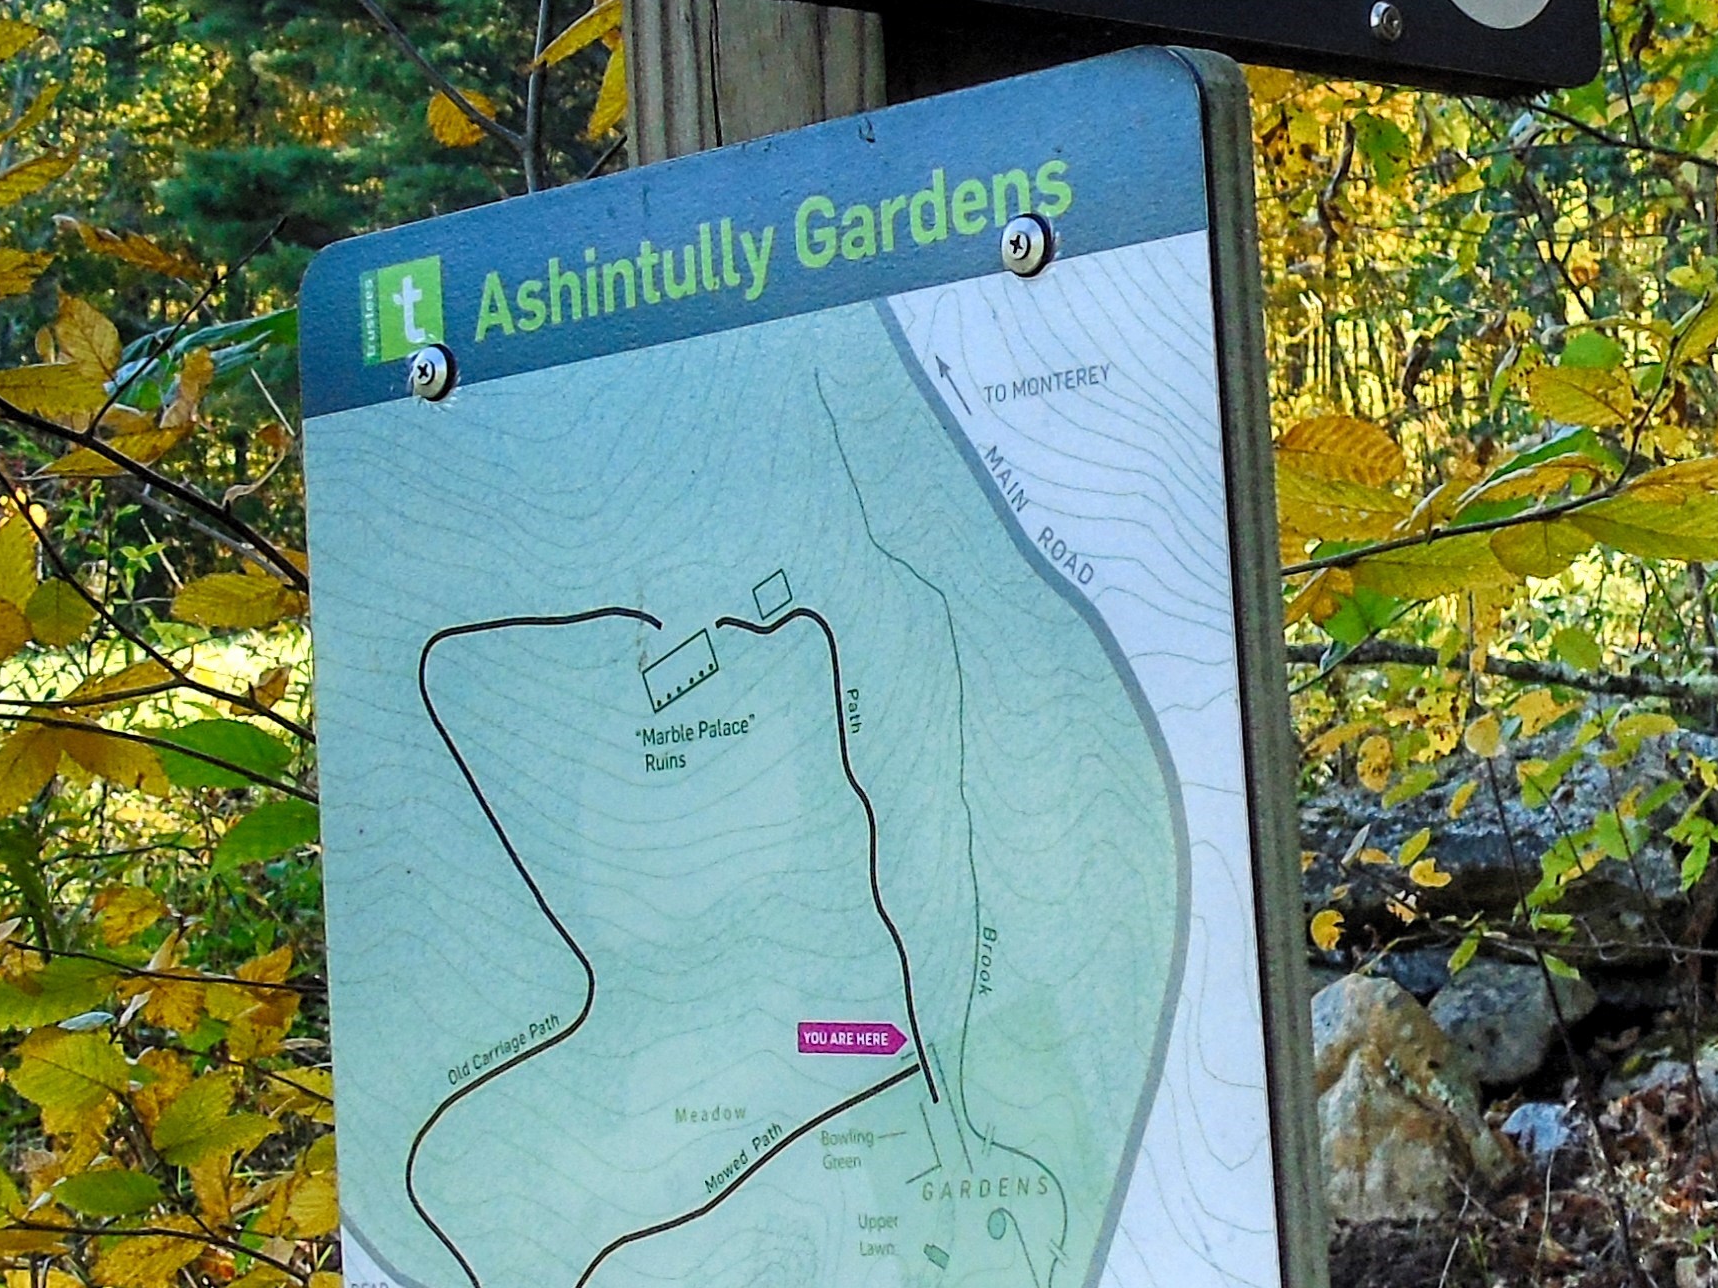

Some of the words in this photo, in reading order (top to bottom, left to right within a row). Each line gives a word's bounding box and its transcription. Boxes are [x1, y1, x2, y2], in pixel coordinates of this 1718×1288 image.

[474, 218, 774, 342] Ashintully
[795, 160, 1073, 269] Gardens
[984, 383, 1007, 403] TO
[1013, 364, 1110, 400] MONTEREY
[984, 445, 1031, 512] MAIN
[1038, 526, 1094, 585] ROAD
[846, 688, 863, 734] Path
[645, 752, 687, 772] Ruins
[978, 926, 998, 996] Brook
[448, 1062, 471, 1086] Old
[472, 1031, 527, 1070] Carriage
[529, 1014, 561, 1041] Path
[803, 1032, 827, 1045] YOU
[830, 1032, 853, 1045] ARE
[856, 1032, 889, 1046] HERE
[674, 1105, 747, 1124] Meadow
[820, 1130, 875, 1148] Bowling
[704, 1149, 749, 1194] Mowed
[751, 1123, 784, 1154] Path
[822, 1154, 862, 1171] Green
[922, 1176, 1049, 1201] GARDENS
[858, 1214, 898, 1232] Upper
[859, 1240, 895, 1257] Lawn
